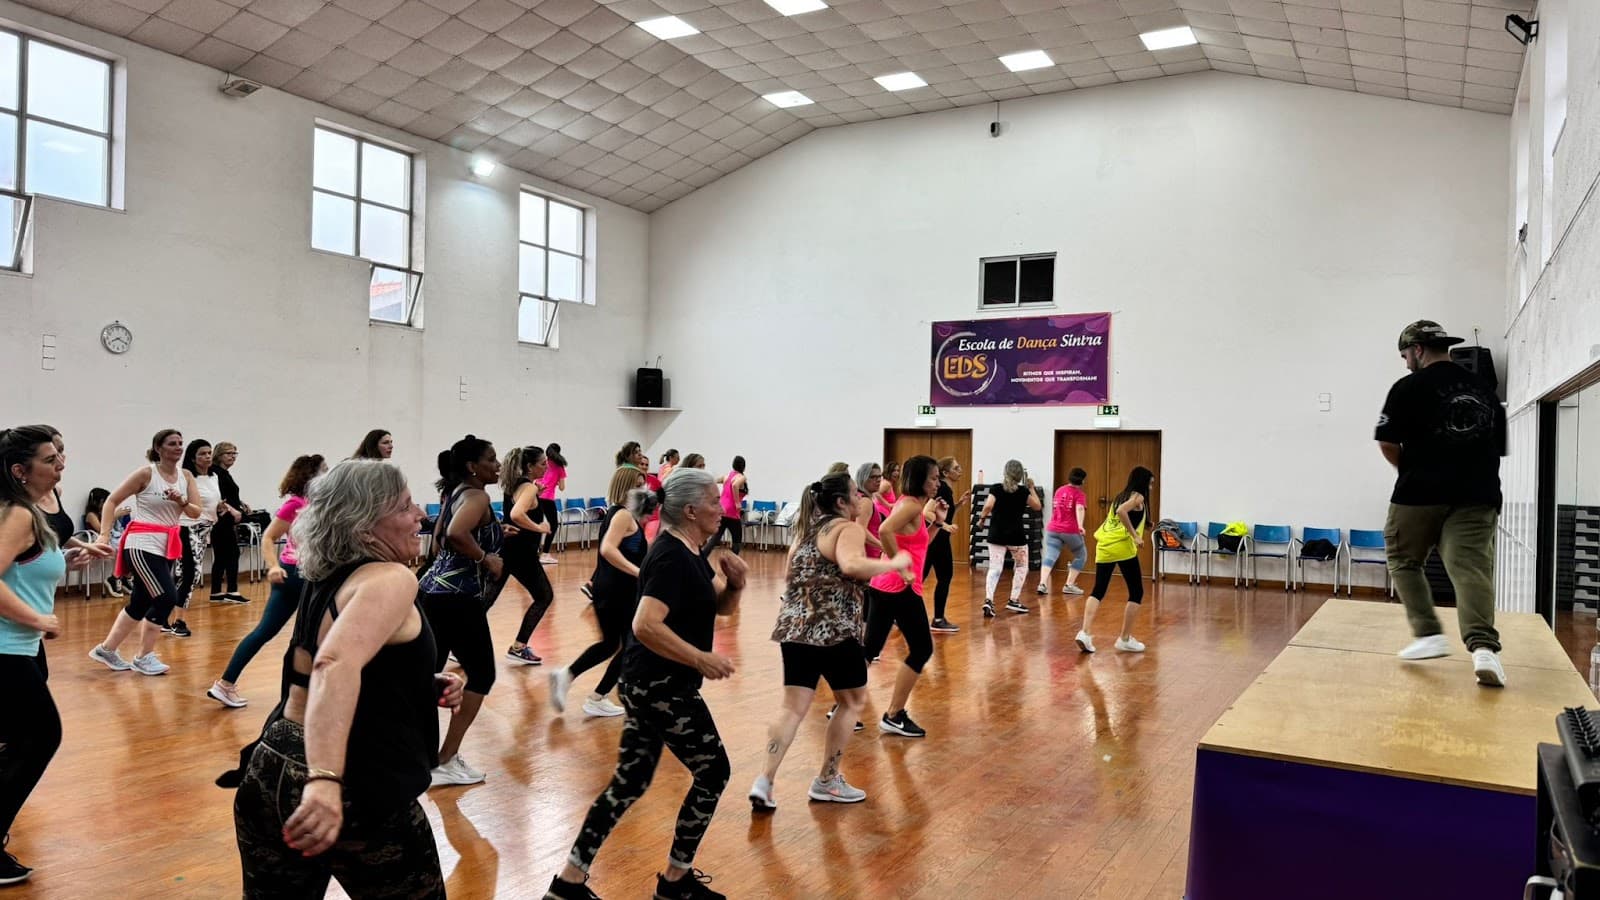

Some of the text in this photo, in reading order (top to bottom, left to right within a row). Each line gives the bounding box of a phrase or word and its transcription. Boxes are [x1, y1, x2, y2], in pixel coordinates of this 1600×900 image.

[958, 334, 1103, 352] Escola de Dança Sintra
[943, 353, 988, 379] EDS
